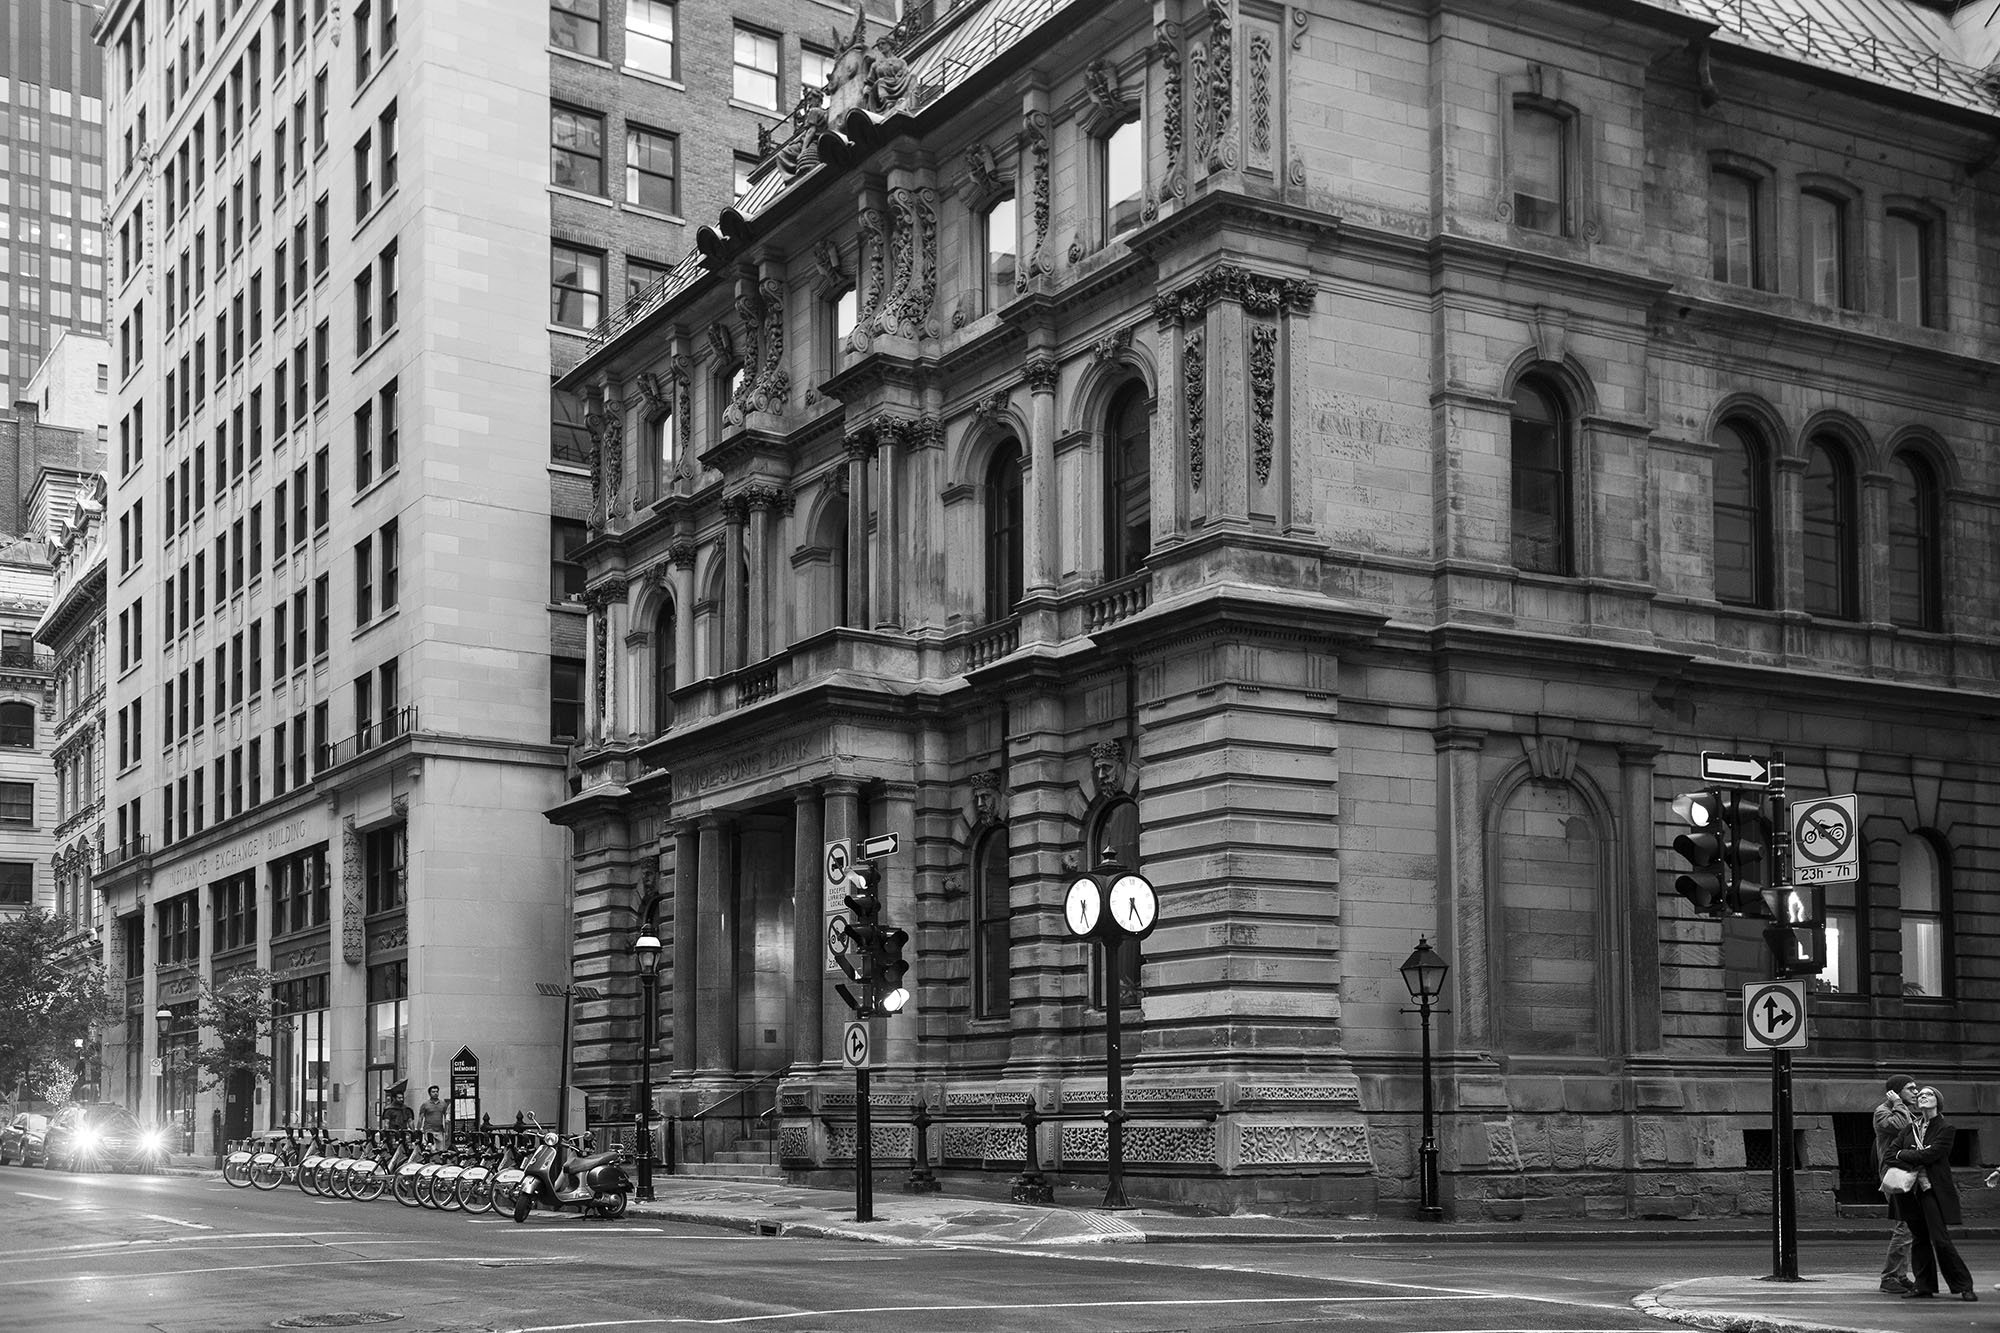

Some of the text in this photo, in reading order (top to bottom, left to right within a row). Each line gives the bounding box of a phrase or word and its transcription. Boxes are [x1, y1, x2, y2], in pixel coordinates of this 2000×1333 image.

[169, 819, 306, 888] INSURANCE EXCHANGE BUILDING
[1801, 868, 1824, 880] 23h
[1835, 865, 1850, 876] 7h
